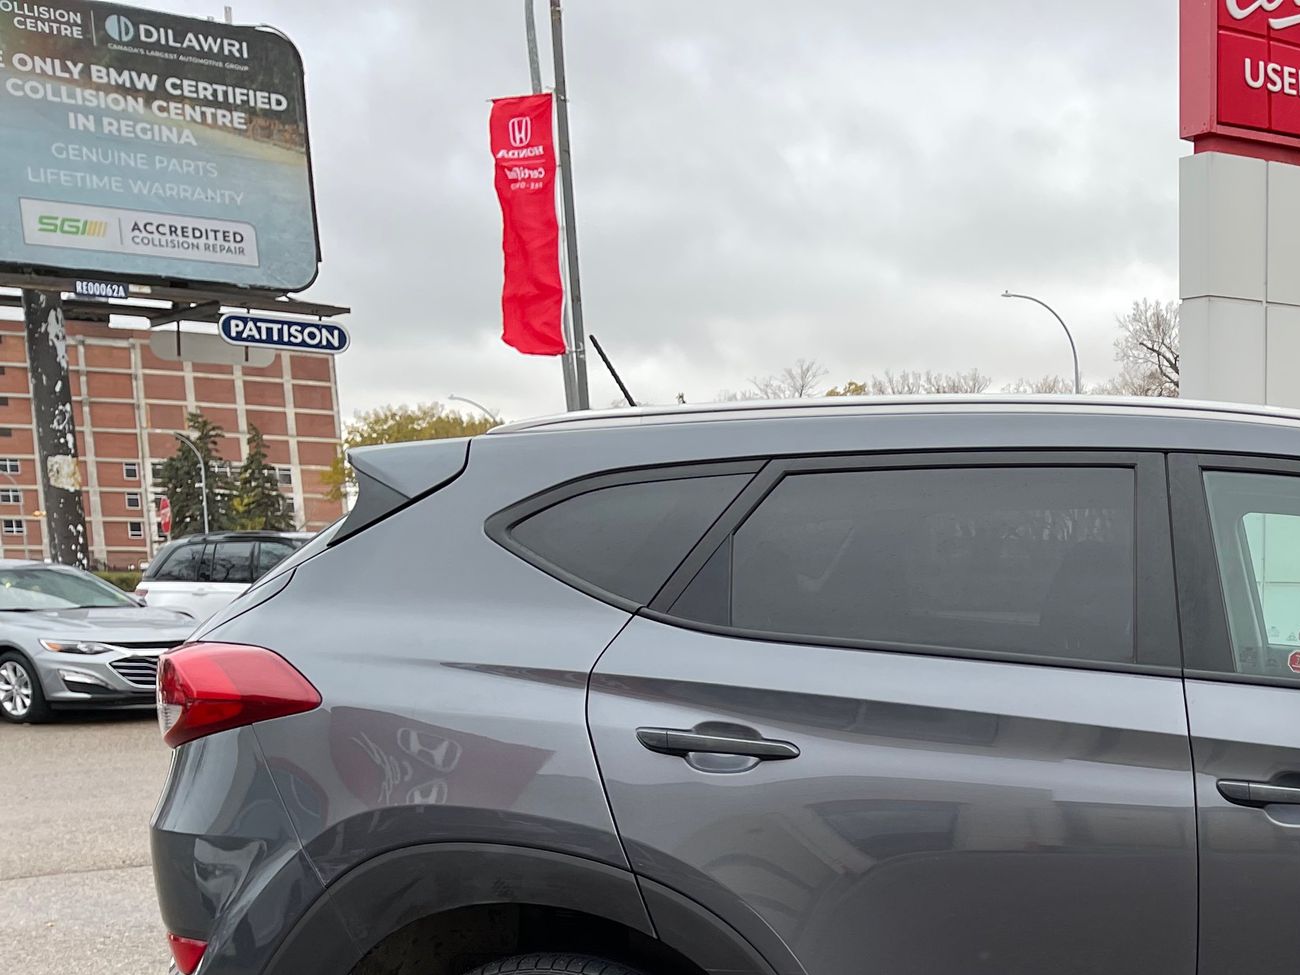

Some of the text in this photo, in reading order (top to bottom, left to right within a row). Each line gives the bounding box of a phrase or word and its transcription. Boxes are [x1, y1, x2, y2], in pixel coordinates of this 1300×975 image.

[0, 0, 82, 24] OLLISION
[13, 17, 83, 39] CENTRE
[138, 23, 249, 59] DILAWRI
[12, 53, 84, 80] ONLY
[90, 64, 159, 92] BMW
[164, 77, 288, 111] CERTIFIED
[6, 78, 248, 130] COLLISION CENTRE
[68, 111, 198, 146] IN REGINA
[51, 142, 218, 178] GENUINE PARTS
[27, 166, 245, 206] LIFETIME WARRANTY
[37, 215, 89, 236] SGI
[131, 221, 244, 244] ACCREDITED
[131, 235, 246, 256] COLLISION REPAIR
[75, 280, 126, 297] RE00062A
[229, 319, 340, 347] PATTISON
